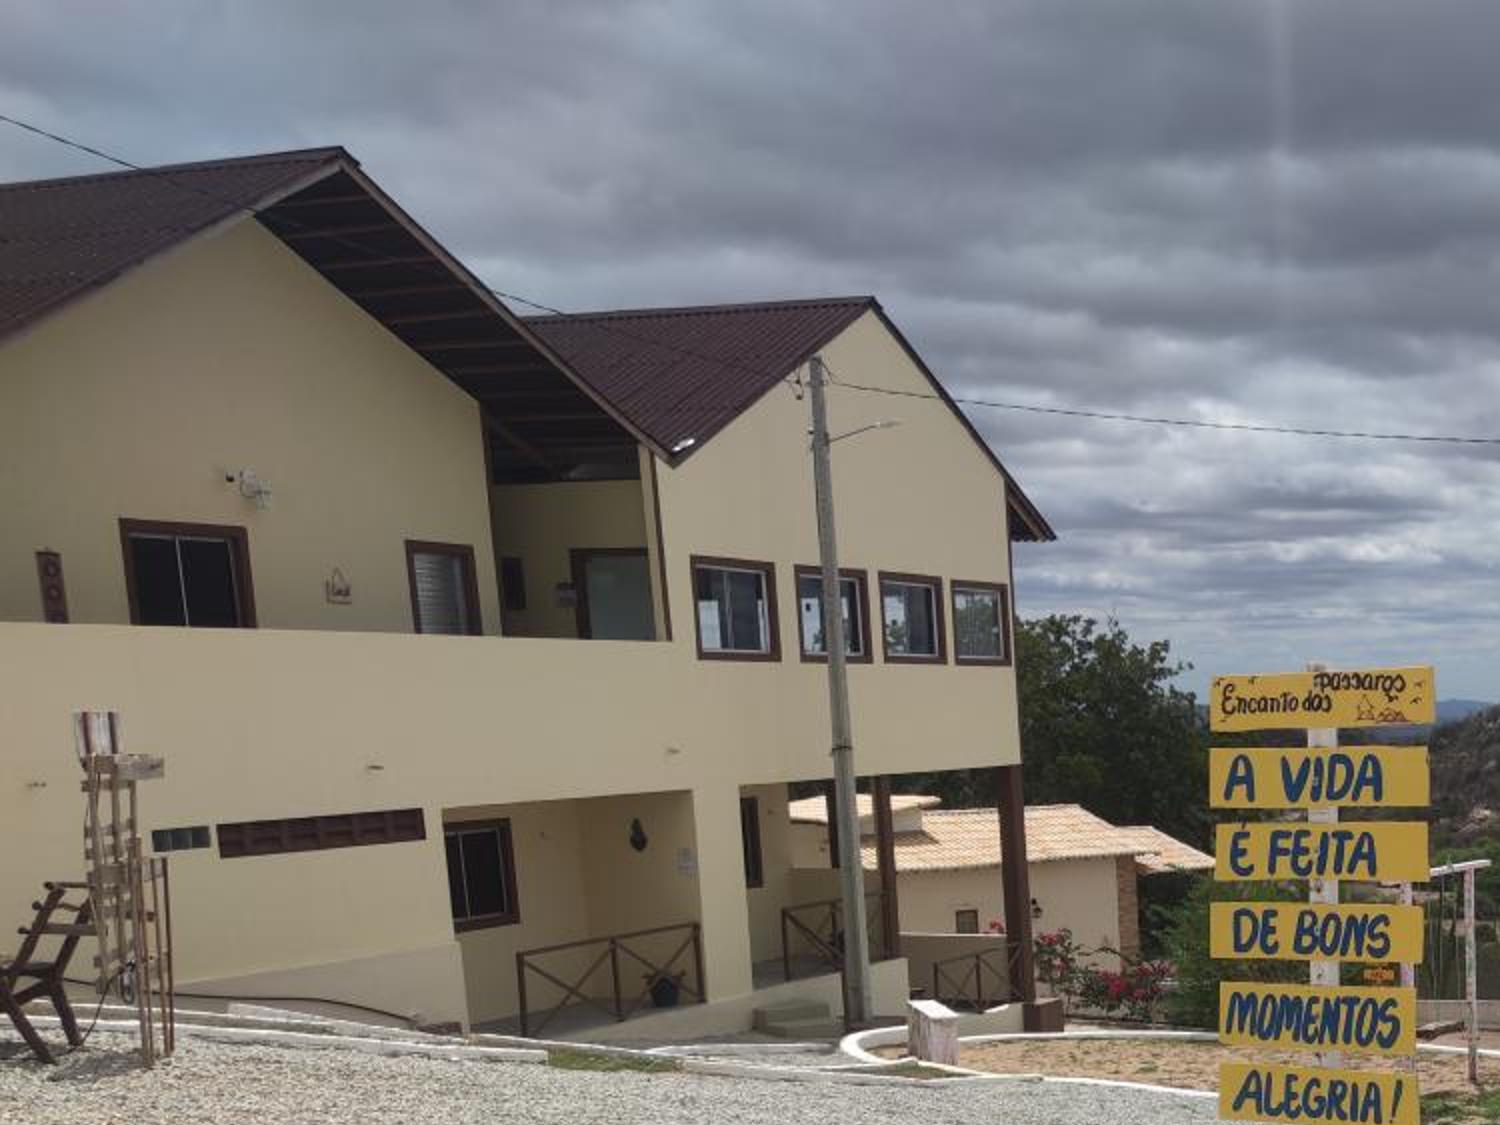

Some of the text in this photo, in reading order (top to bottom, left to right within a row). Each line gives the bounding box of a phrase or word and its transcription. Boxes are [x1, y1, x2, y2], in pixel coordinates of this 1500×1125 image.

[1221, 683, 1333, 715] Encanto dos
[1224, 753, 1383, 803] A VIDA
[1268, 829, 1377, 877] FEITA
[1233, 908, 1391, 959] DE BONS
[1225, 991, 1401, 1049] MOMENTOS
[1232, 1069, 1404, 1125] ALEGRIA!
